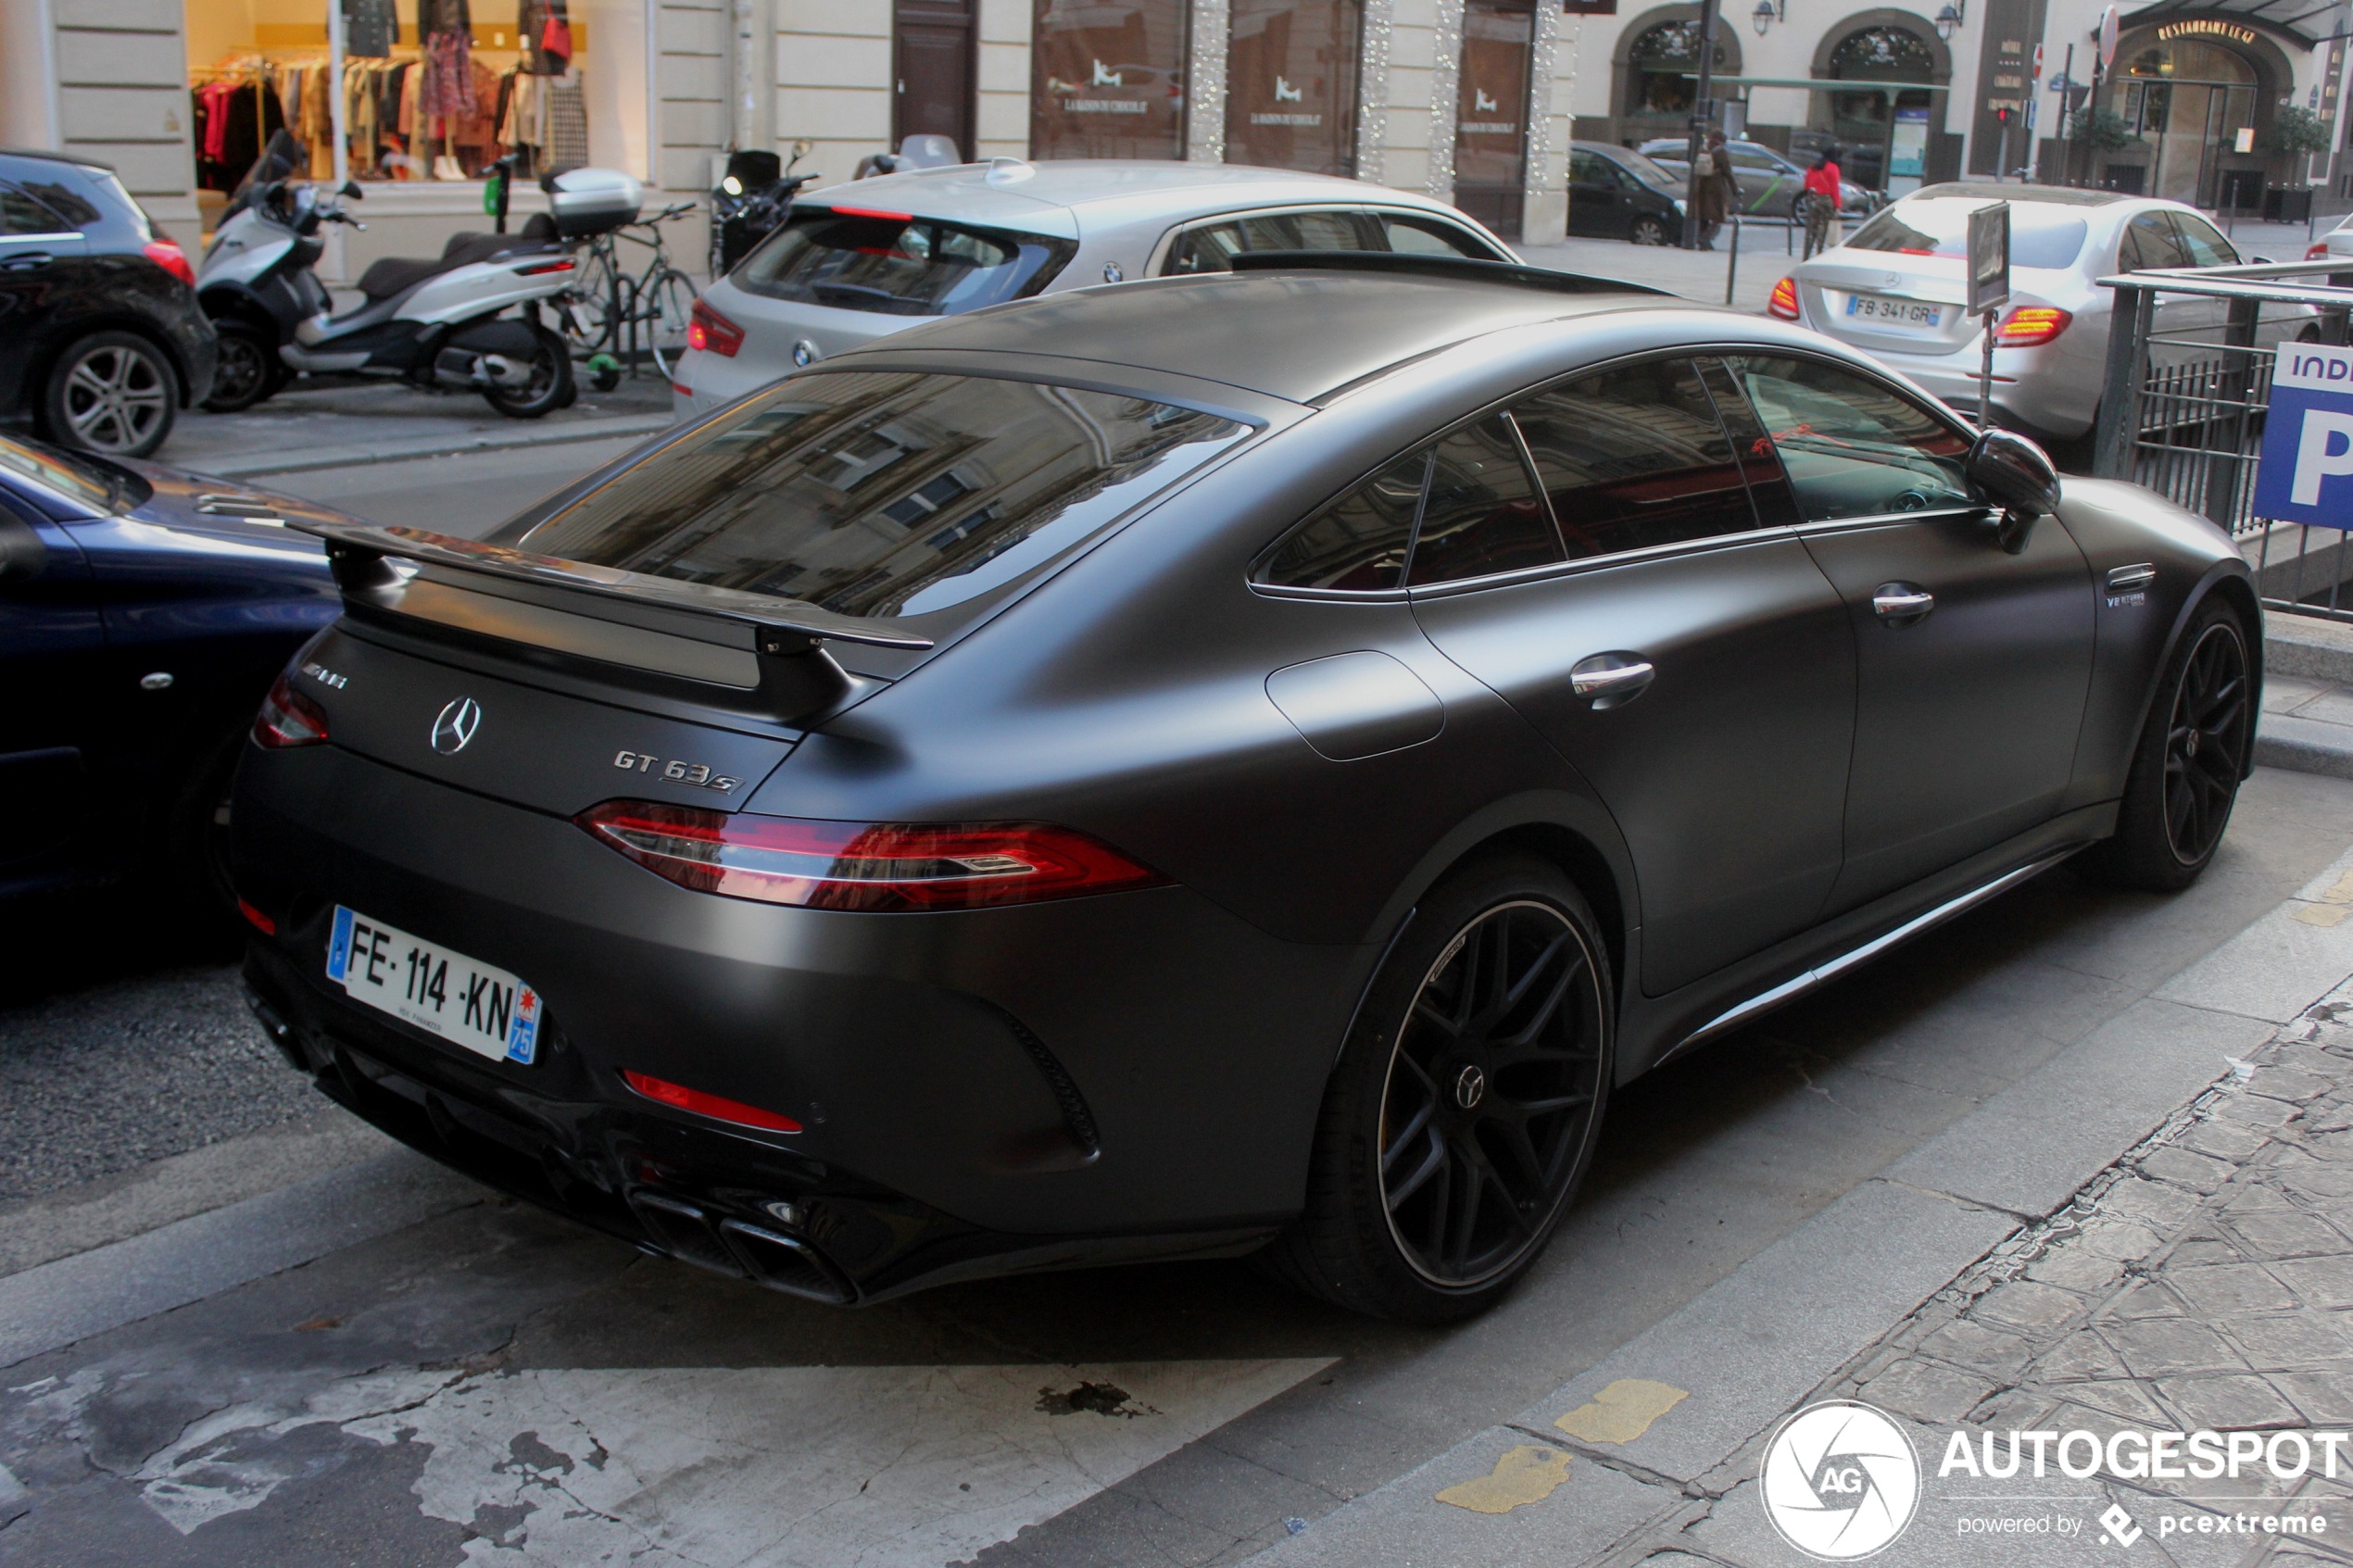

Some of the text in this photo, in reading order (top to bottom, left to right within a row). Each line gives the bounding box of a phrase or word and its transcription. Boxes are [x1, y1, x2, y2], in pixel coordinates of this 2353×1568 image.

[2158, 19, 2227, 41] RESTAURANT
[2290, 408, 2353, 507] P
[614, 750, 659, 773] GT
[511, 1025, 531, 1056] 75
